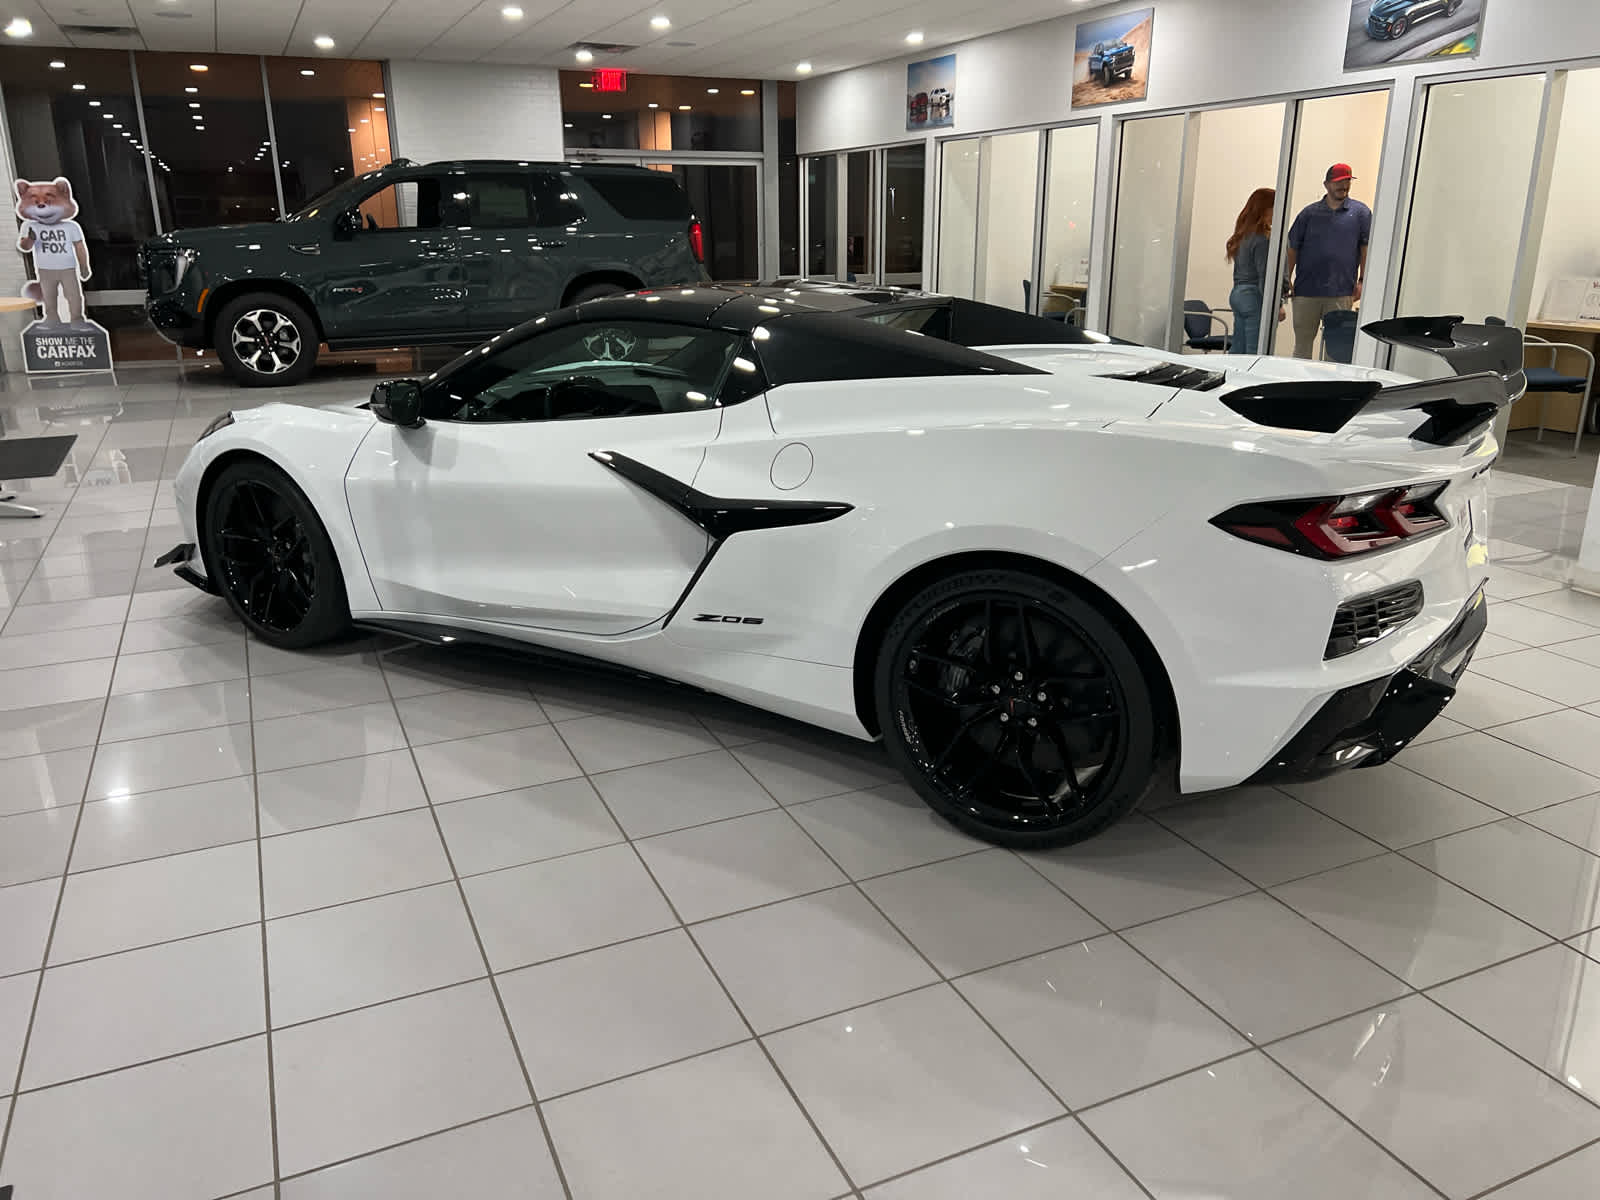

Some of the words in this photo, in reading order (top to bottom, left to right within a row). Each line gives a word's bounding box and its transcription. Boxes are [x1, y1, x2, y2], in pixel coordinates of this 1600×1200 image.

[40, 230, 66, 242] CAR
[42, 242, 67, 254] FOX
[35, 337, 63, 346] SHOW
[37, 345, 96, 359] CARFAX
[692, 613, 764, 625] Z06
